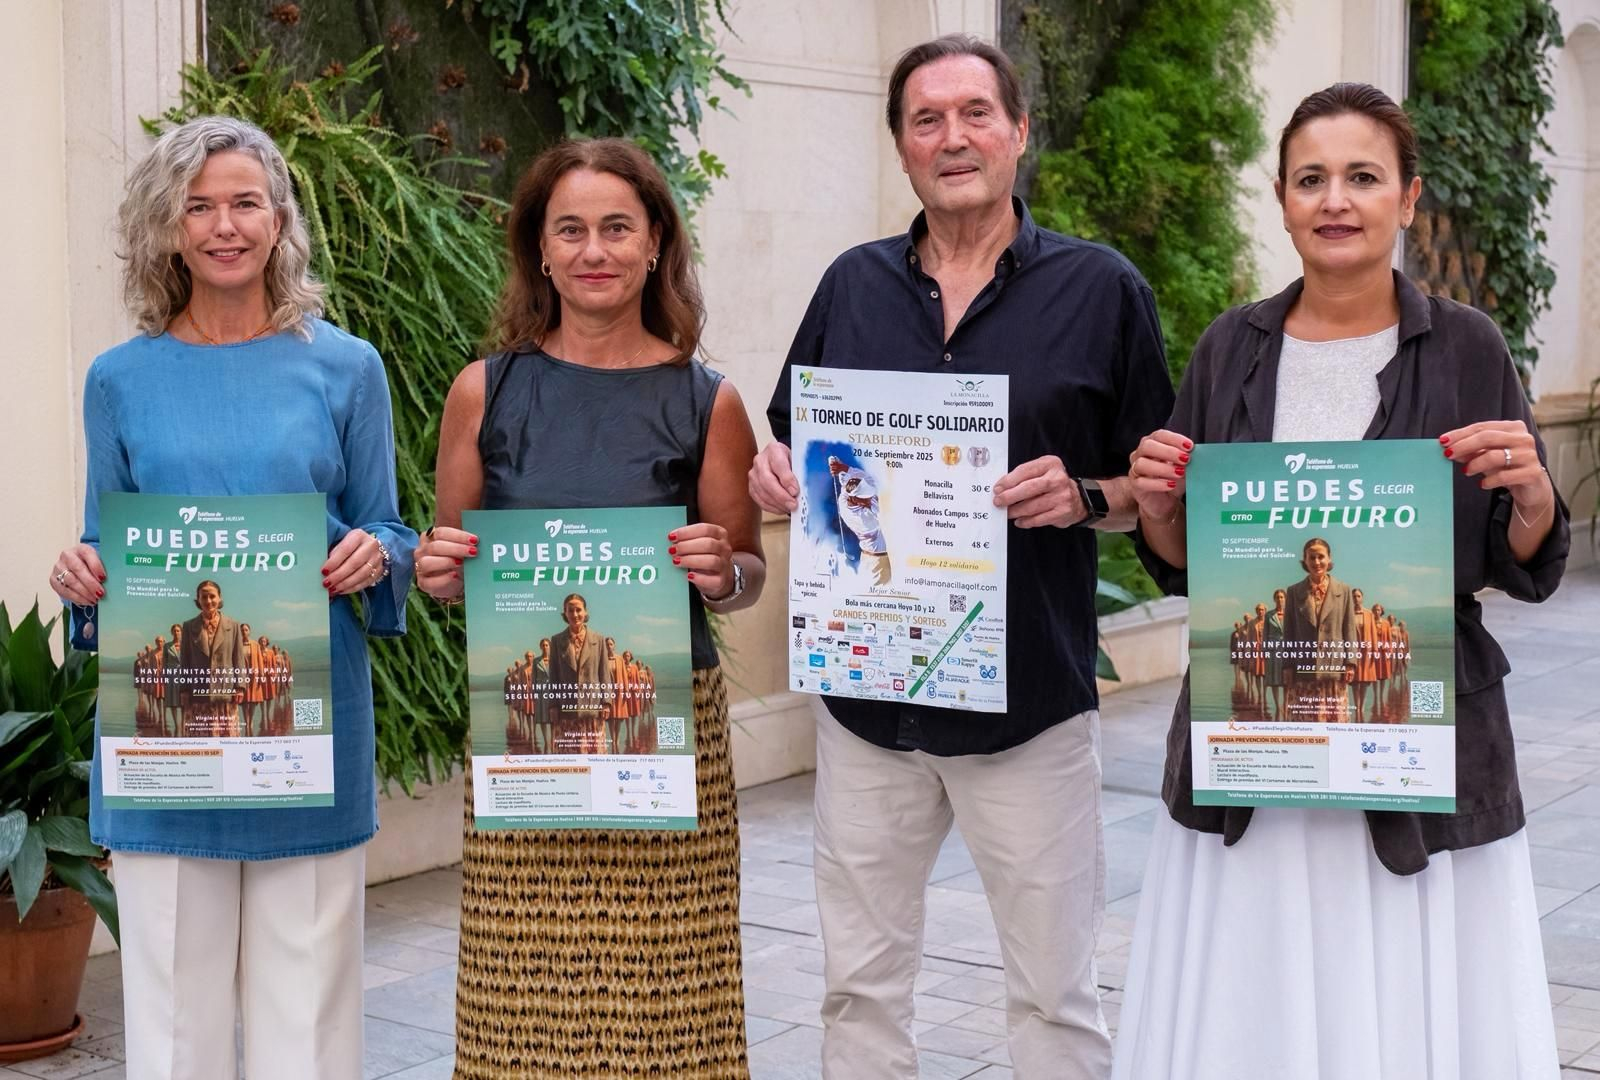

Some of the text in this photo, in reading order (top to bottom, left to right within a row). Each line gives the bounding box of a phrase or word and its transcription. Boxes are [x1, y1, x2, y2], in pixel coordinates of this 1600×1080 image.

[796, 407, 1004, 432] IX TORNEO DE GOLF SOLIDARIO
[848, 433, 931, 447] STABLEFORD
[875, 450, 914, 460] Septiembre
[917, 452, 933, 461] 2025
[925, 480, 953, 488] Monacilla
[1222, 479, 1414, 503] PUEDES ELEGIR
[924, 491, 954, 500] Bellavista
[913, 507, 942, 516] Abonados
[944, 509, 969, 518] Campos
[1268, 506, 1416, 529] FUTURO
[935, 520, 956, 528] Huelva
[127, 528, 294, 549] PUEDES ELEGIR
[926, 538, 953, 547] Externos
[493, 542, 655, 563] PUEDES ELEGIR
[165, 552, 295, 572] FUTURO
[950, 562, 979, 570] solidario
[533, 565, 656, 586] FUTURO
[905, 578, 998, 591] info@lamonacillagolf.com
[833, 609, 868, 619] GRANDES
[870, 612, 903, 622] PREMIOS
[913, 616, 947, 627] SORTEOS
